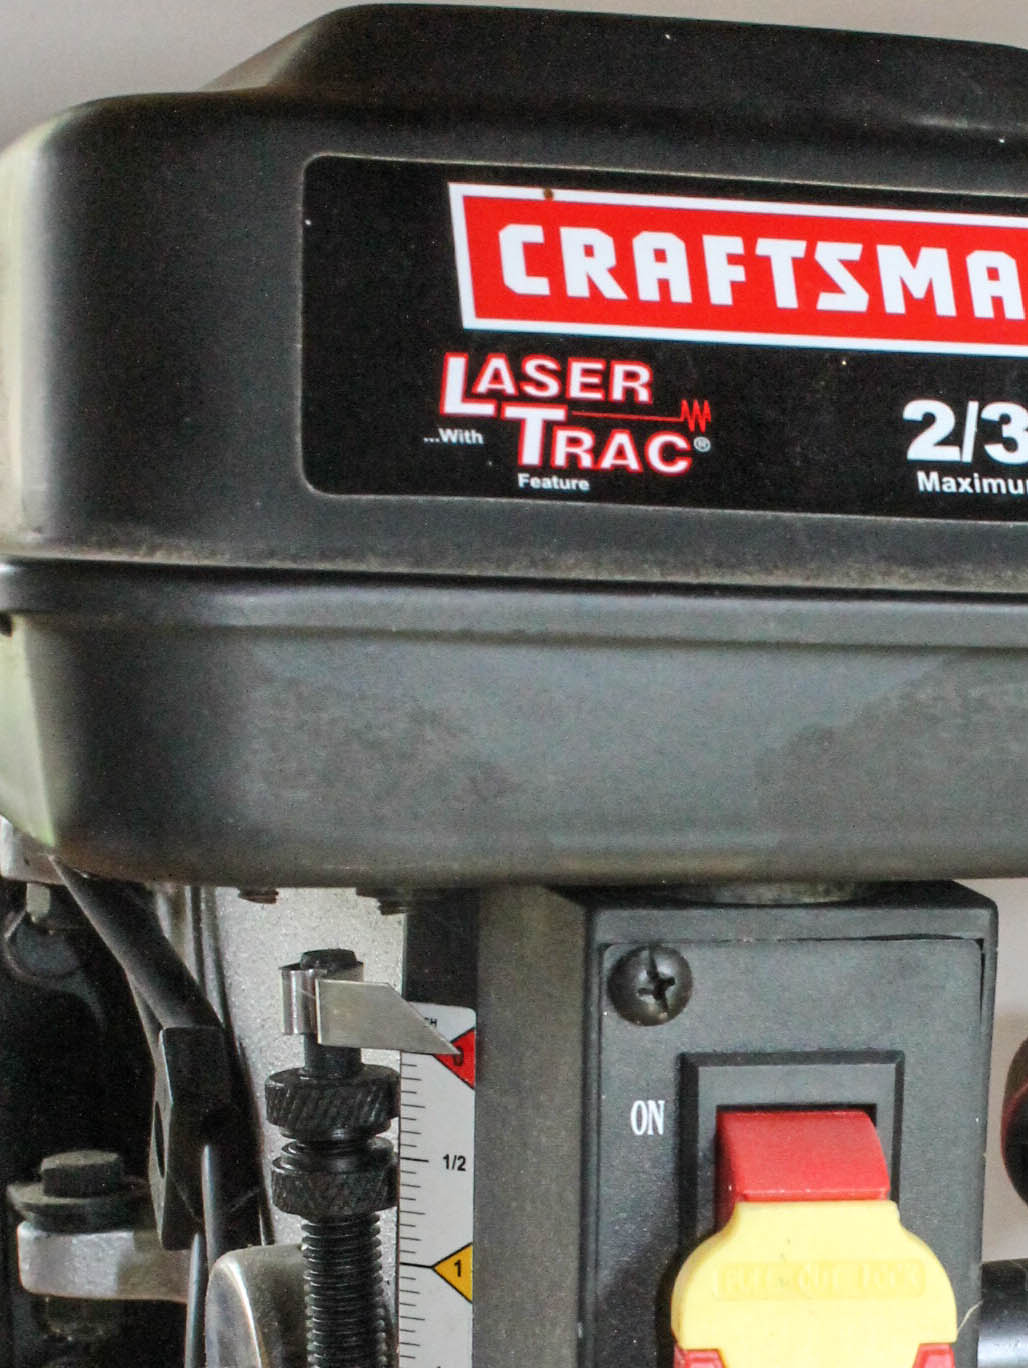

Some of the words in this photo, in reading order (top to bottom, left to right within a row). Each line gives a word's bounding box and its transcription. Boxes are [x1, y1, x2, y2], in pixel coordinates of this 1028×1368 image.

[440, 352, 653, 417] LASER
[517, 472, 591, 492] Feature
[630, 1100, 665, 1136] ON
[442, 1154, 467, 1172] 1/2
[453, 1259, 462, 1278] 1
